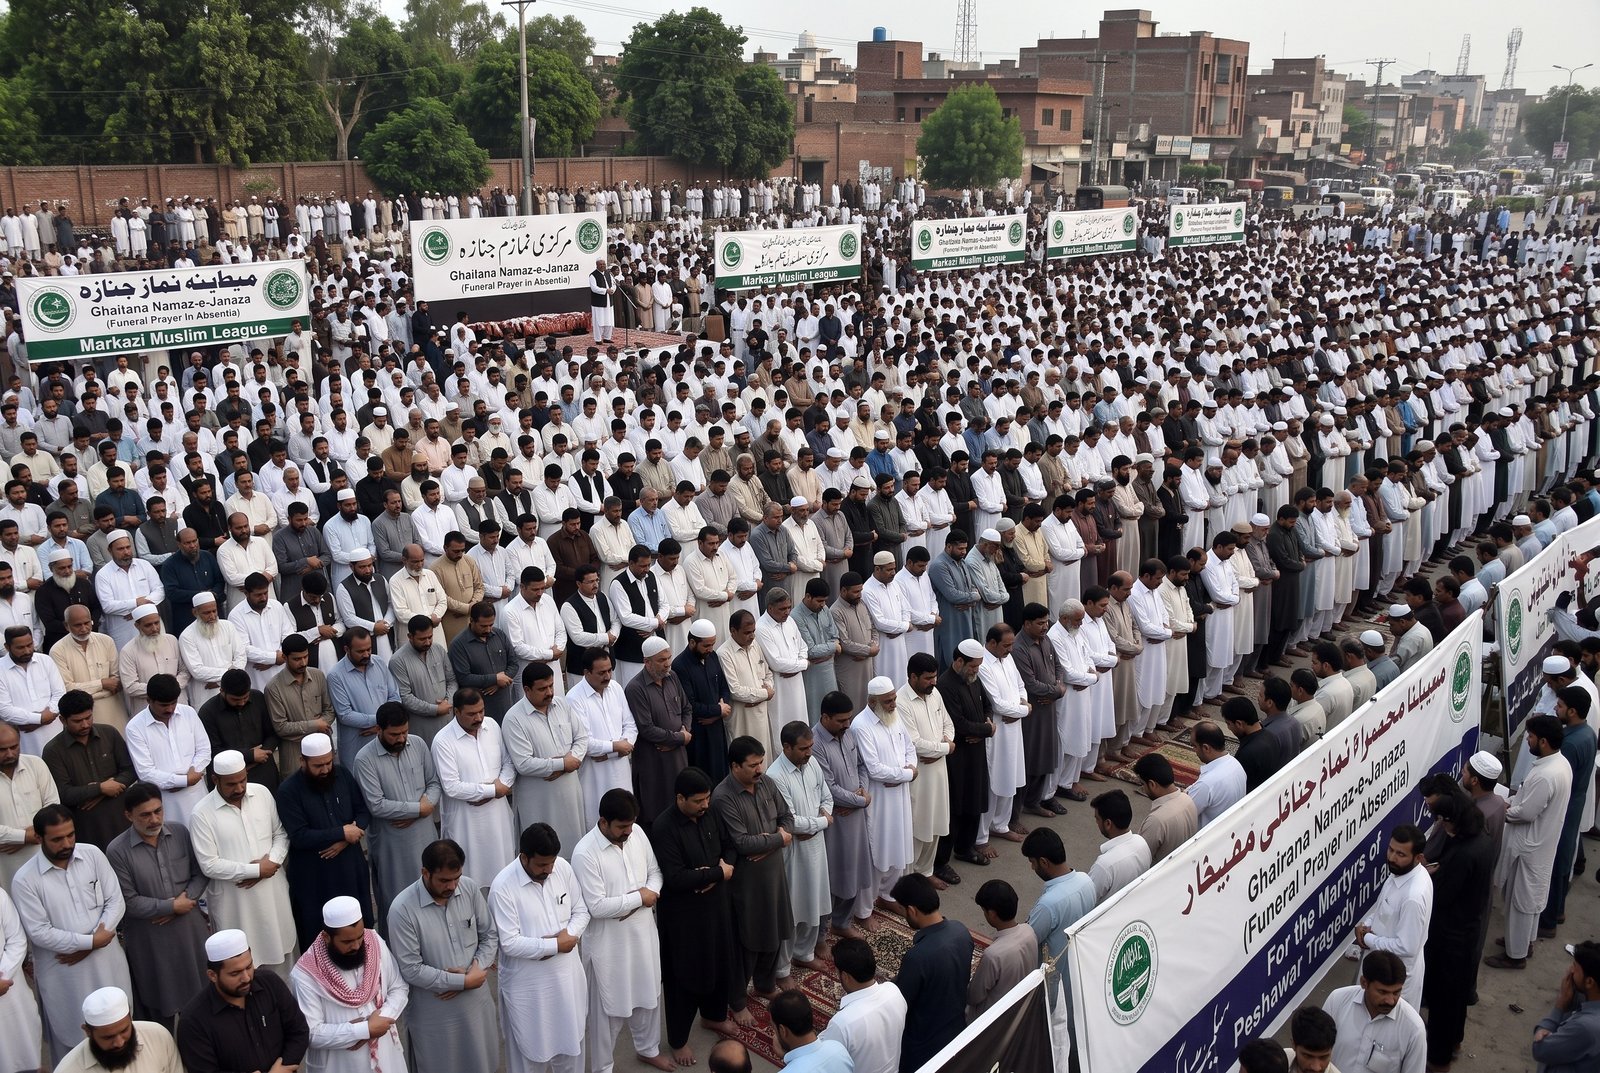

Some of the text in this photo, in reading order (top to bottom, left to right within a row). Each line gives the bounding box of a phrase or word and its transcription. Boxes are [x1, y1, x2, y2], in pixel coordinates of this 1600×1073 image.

[499, 263, 579, 277] Namaz-e-Janaza
[931, 254, 1006, 268] Markazi Muslim League
[461, 281, 495, 294] (Funeral
[497, 279, 522, 290] Prayer
[534, 276, 571, 286] Absentia)
[742, 270, 838, 286] Markazi Muslim League
[91, 296, 251, 317] Ghaitana Namaz-e-Janaza
[106, 316, 148, 330] (Funeral
[151, 312, 182, 325] Prayer
[196, 308, 240, 320] Absentia)
[79, 324, 268, 352] Markazi Muslim League
[1248, 830, 1310, 902] Ghairana
[1314, 739, 1405, 839] Namaz-e-Janaza
[1244, 761, 1409, 954] (Funeral Prayer in Absentia)
[1267, 830, 1382, 977] For the Martyrs of
[1234, 955, 1303, 1048] Peshawar
[1306, 899, 1356, 965] Tragedy
[1358, 881, 1370, 908] in
